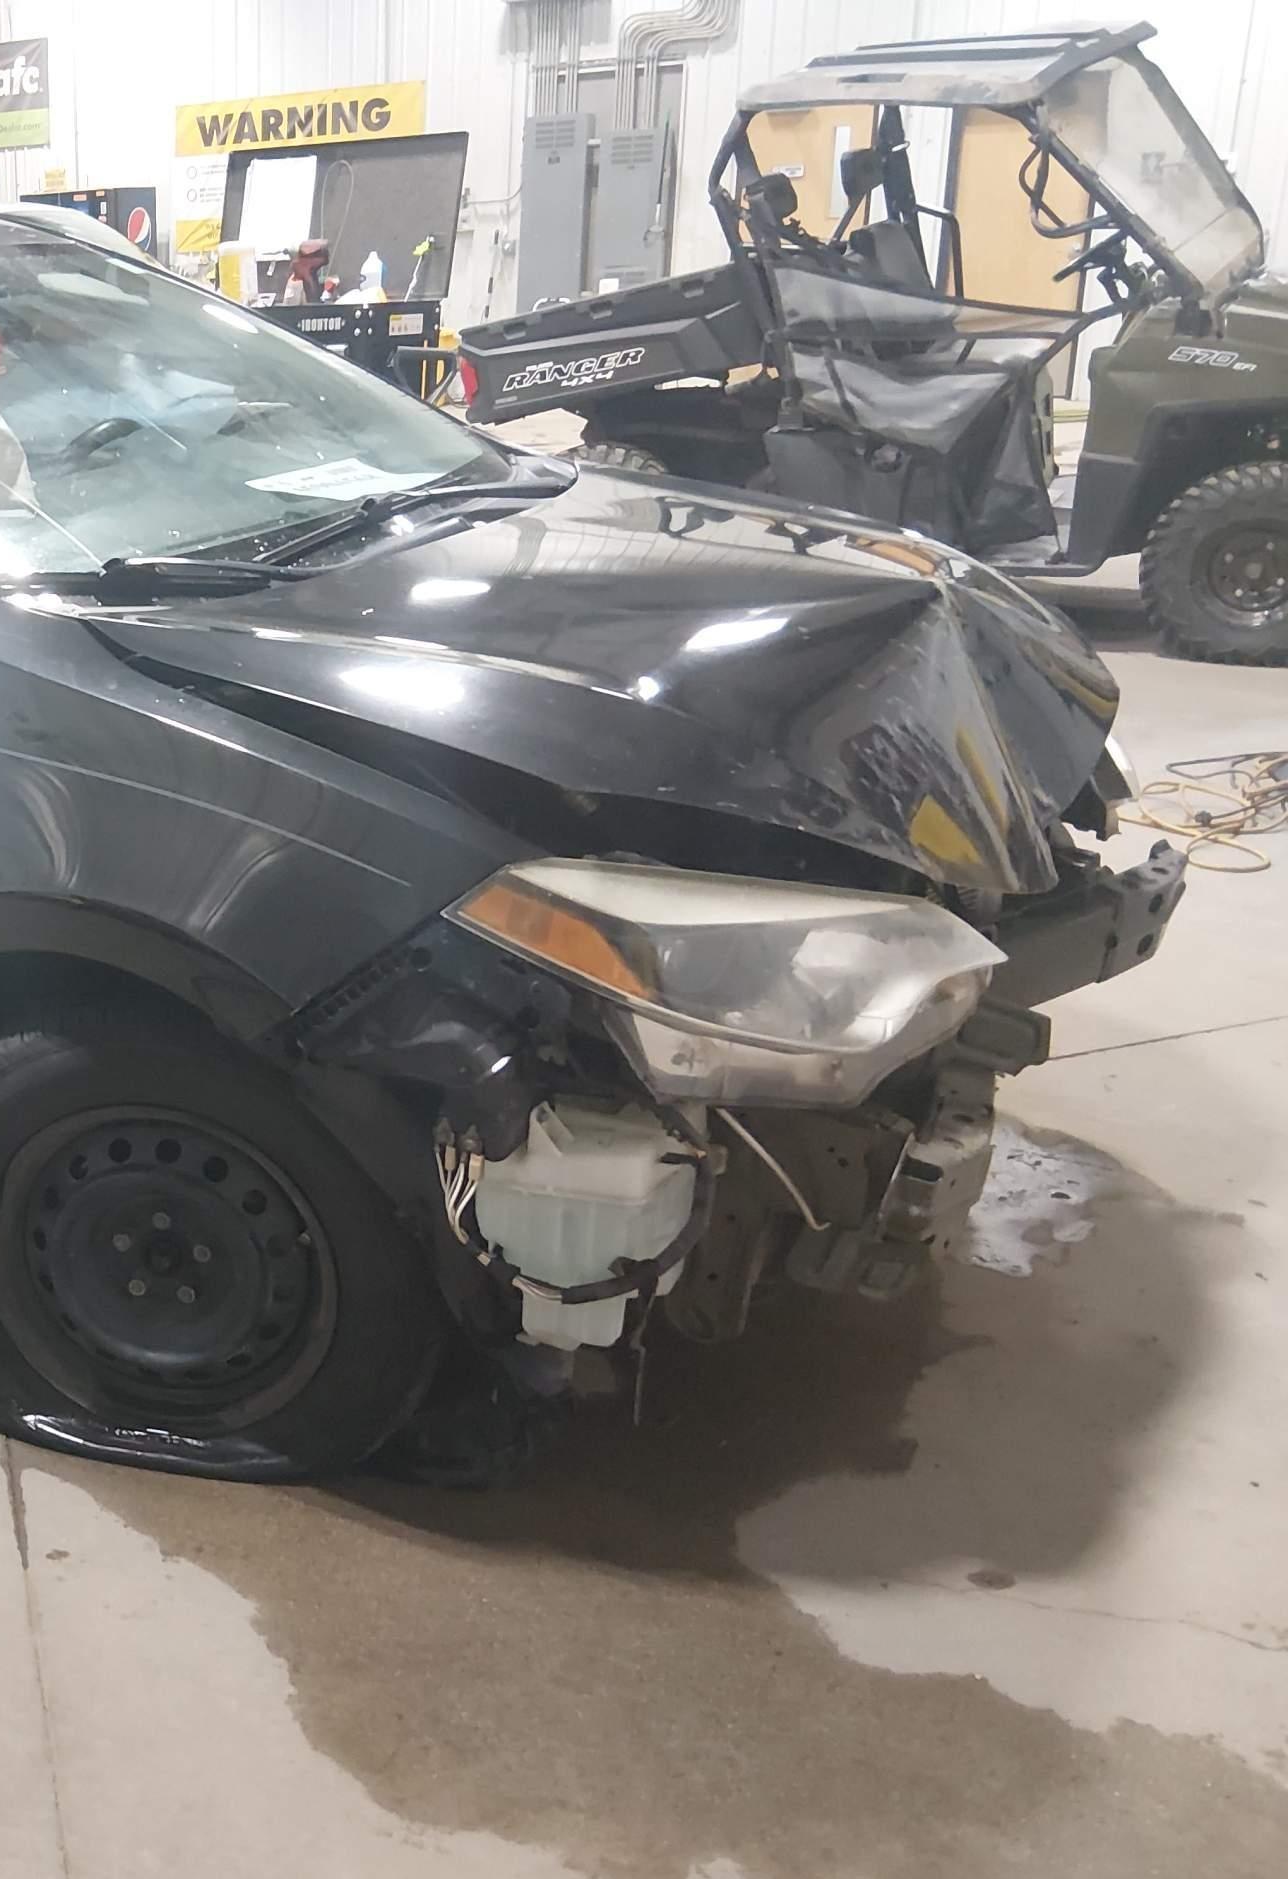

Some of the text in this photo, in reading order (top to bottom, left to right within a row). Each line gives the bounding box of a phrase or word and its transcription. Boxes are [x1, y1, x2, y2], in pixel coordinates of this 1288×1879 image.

[196, 98, 391, 147] WARNING
[301, 317, 341, 332] IRONTON
[502, 347, 646, 391] RANGER
[1168, 346, 1239, 367] 570
